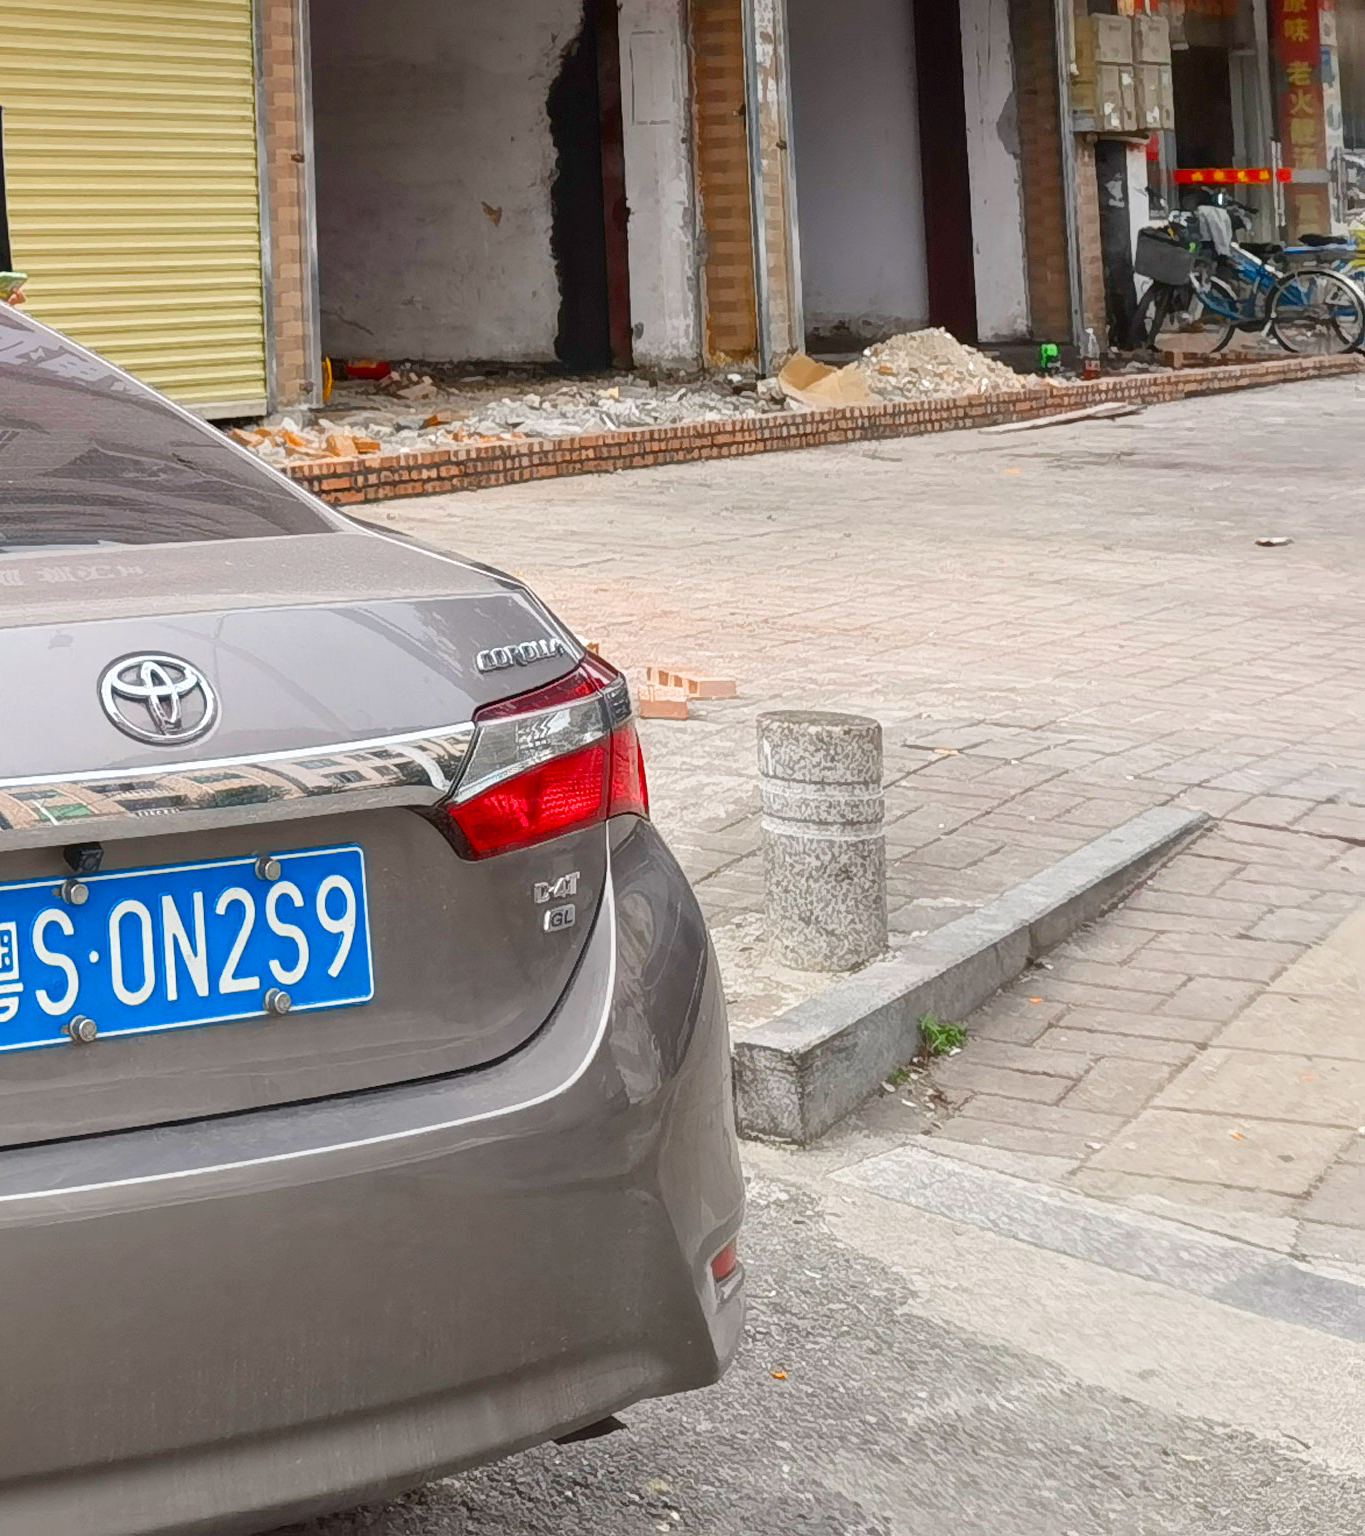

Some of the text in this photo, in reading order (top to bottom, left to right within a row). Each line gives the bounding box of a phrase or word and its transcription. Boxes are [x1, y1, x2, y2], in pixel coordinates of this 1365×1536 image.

[477, 638, 566, 672] COROLLA
[533, 870, 581, 904] D-4T
[551, 910, 574, 927] GL
